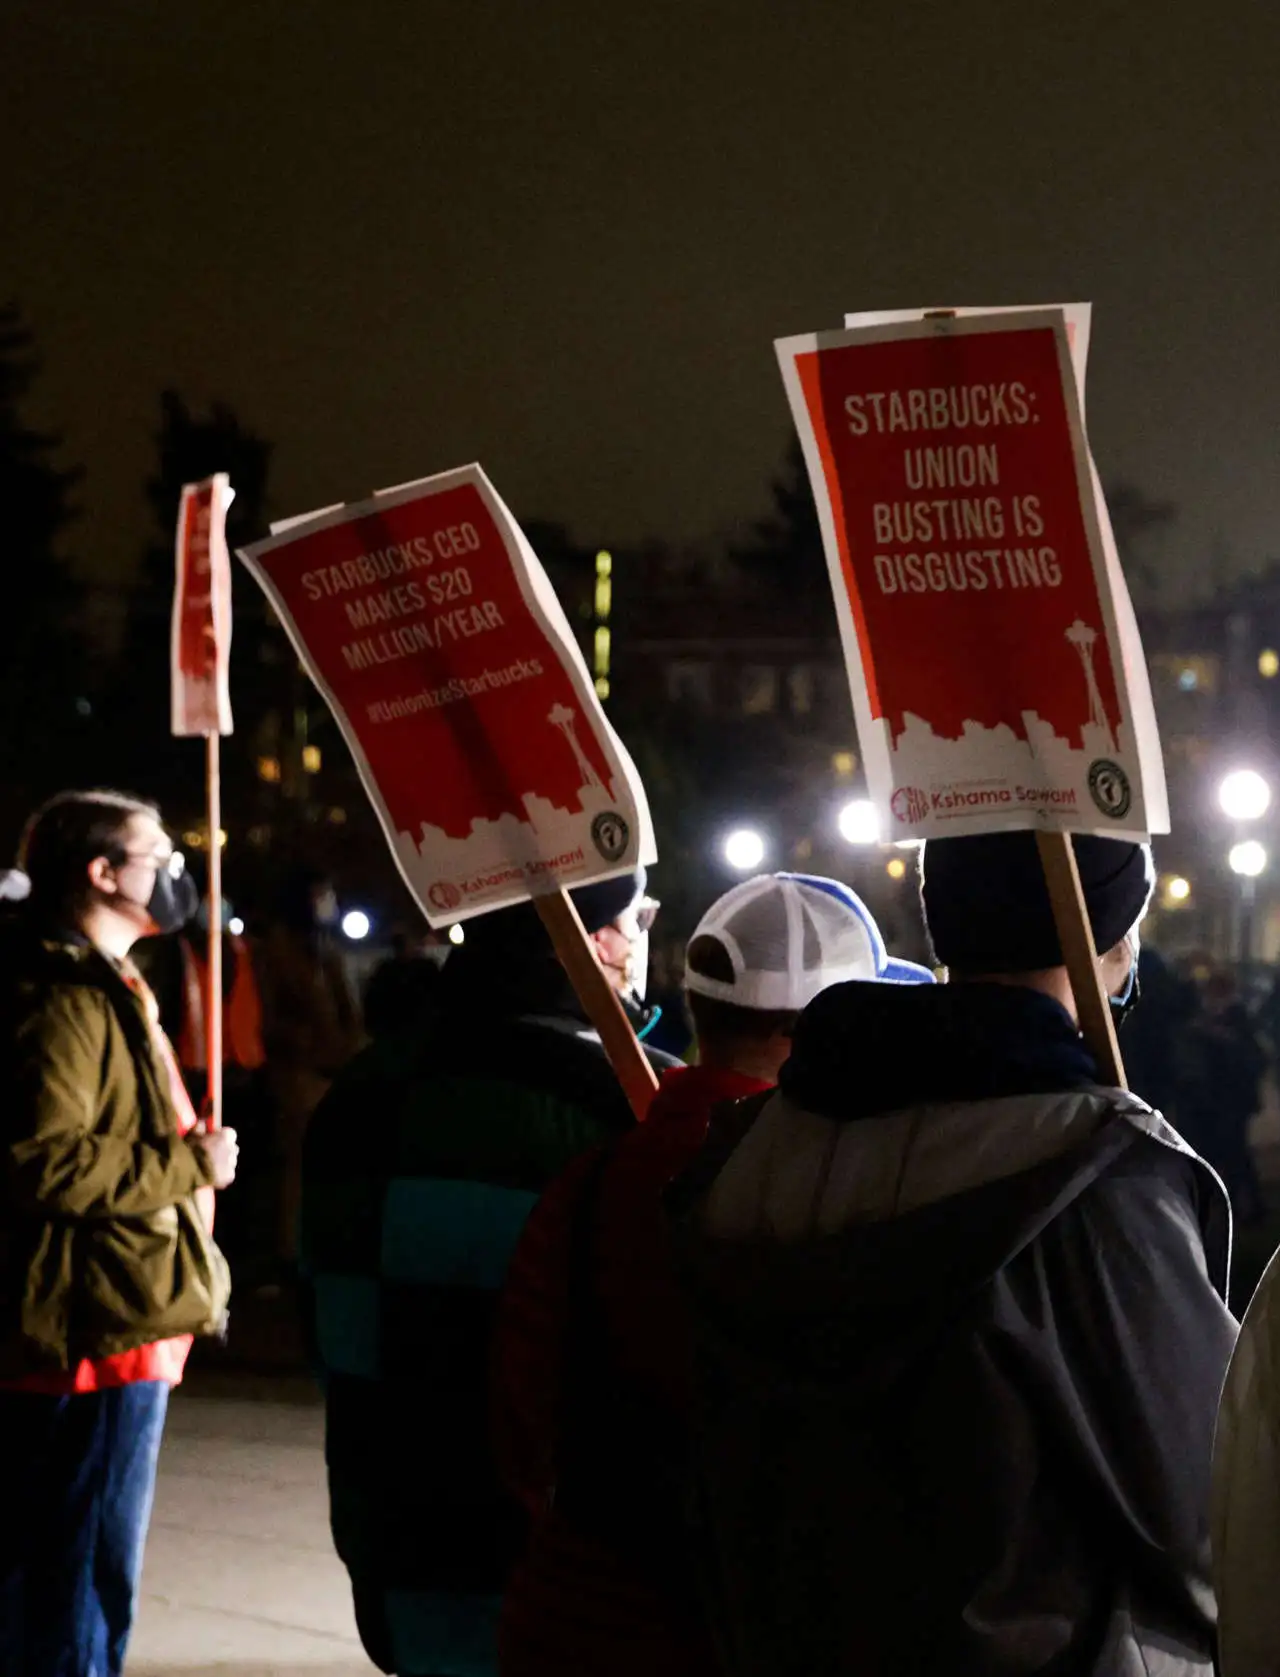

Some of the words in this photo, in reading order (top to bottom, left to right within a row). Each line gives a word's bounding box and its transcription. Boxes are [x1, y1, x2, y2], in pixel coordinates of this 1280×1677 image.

[844, 381, 1040, 436] STARBUCKS:
[904, 443, 999, 490] UNION
[873, 496, 1003, 544] BUSTING
[1014, 494, 1044, 537] IS
[301, 537, 434, 601] STARBUCKS
[433, 522, 481, 559] CEO
[873, 546, 1063, 594] DISGUSTING
[345, 582, 427, 630] MAKES
[425, 567, 473, 605] $20
[341, 600, 505, 671] MILLION/YEAR
[365, 658, 545, 725] #UnionizeStarbucks
[931, 789, 1012, 809] Kshama
[1014, 785, 1077, 804] Sawant
[460, 867, 524, 894] Kshama
